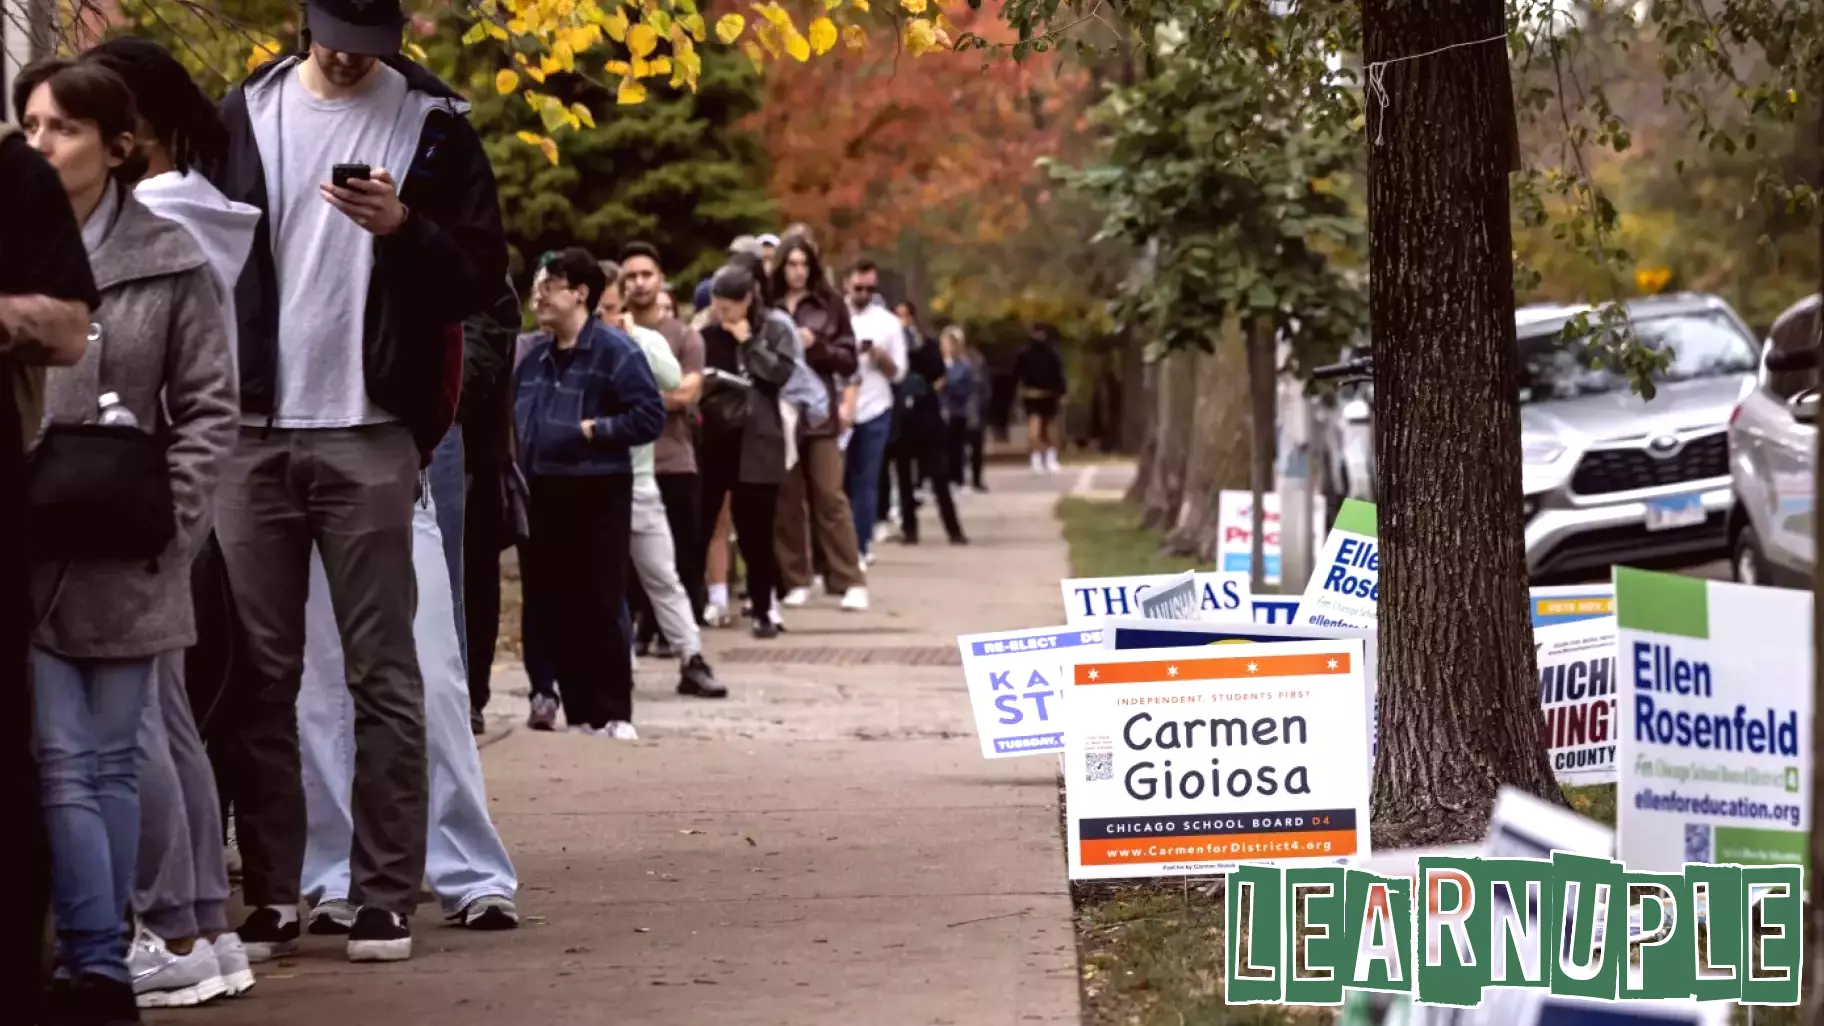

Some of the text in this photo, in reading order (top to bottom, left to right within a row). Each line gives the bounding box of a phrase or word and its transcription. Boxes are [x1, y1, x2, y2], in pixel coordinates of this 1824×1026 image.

[1074, 580, 1241, 617] THAS
[983, 636, 1057, 654] RE-ELECT
[989, 665, 1062, 691] KA
[1632, 640, 1712, 698] Ellen
[995, 690, 1063, 725] ST
[1211, 691, 1273, 701] STUDENTS
[1278, 690, 1311, 700] FIRST
[1123, 712, 1307, 751] Carmen
[1633, 694, 1799, 757] Rosenfeld
[1554, 745, 1617, 770] COUNTY
[1124, 758, 1311, 801] Gioiosa
[1106, 816, 1331, 833] CHICAGO SCHOOL BOARD D4
[1634, 788, 1801, 827] ellenforeducation.org
